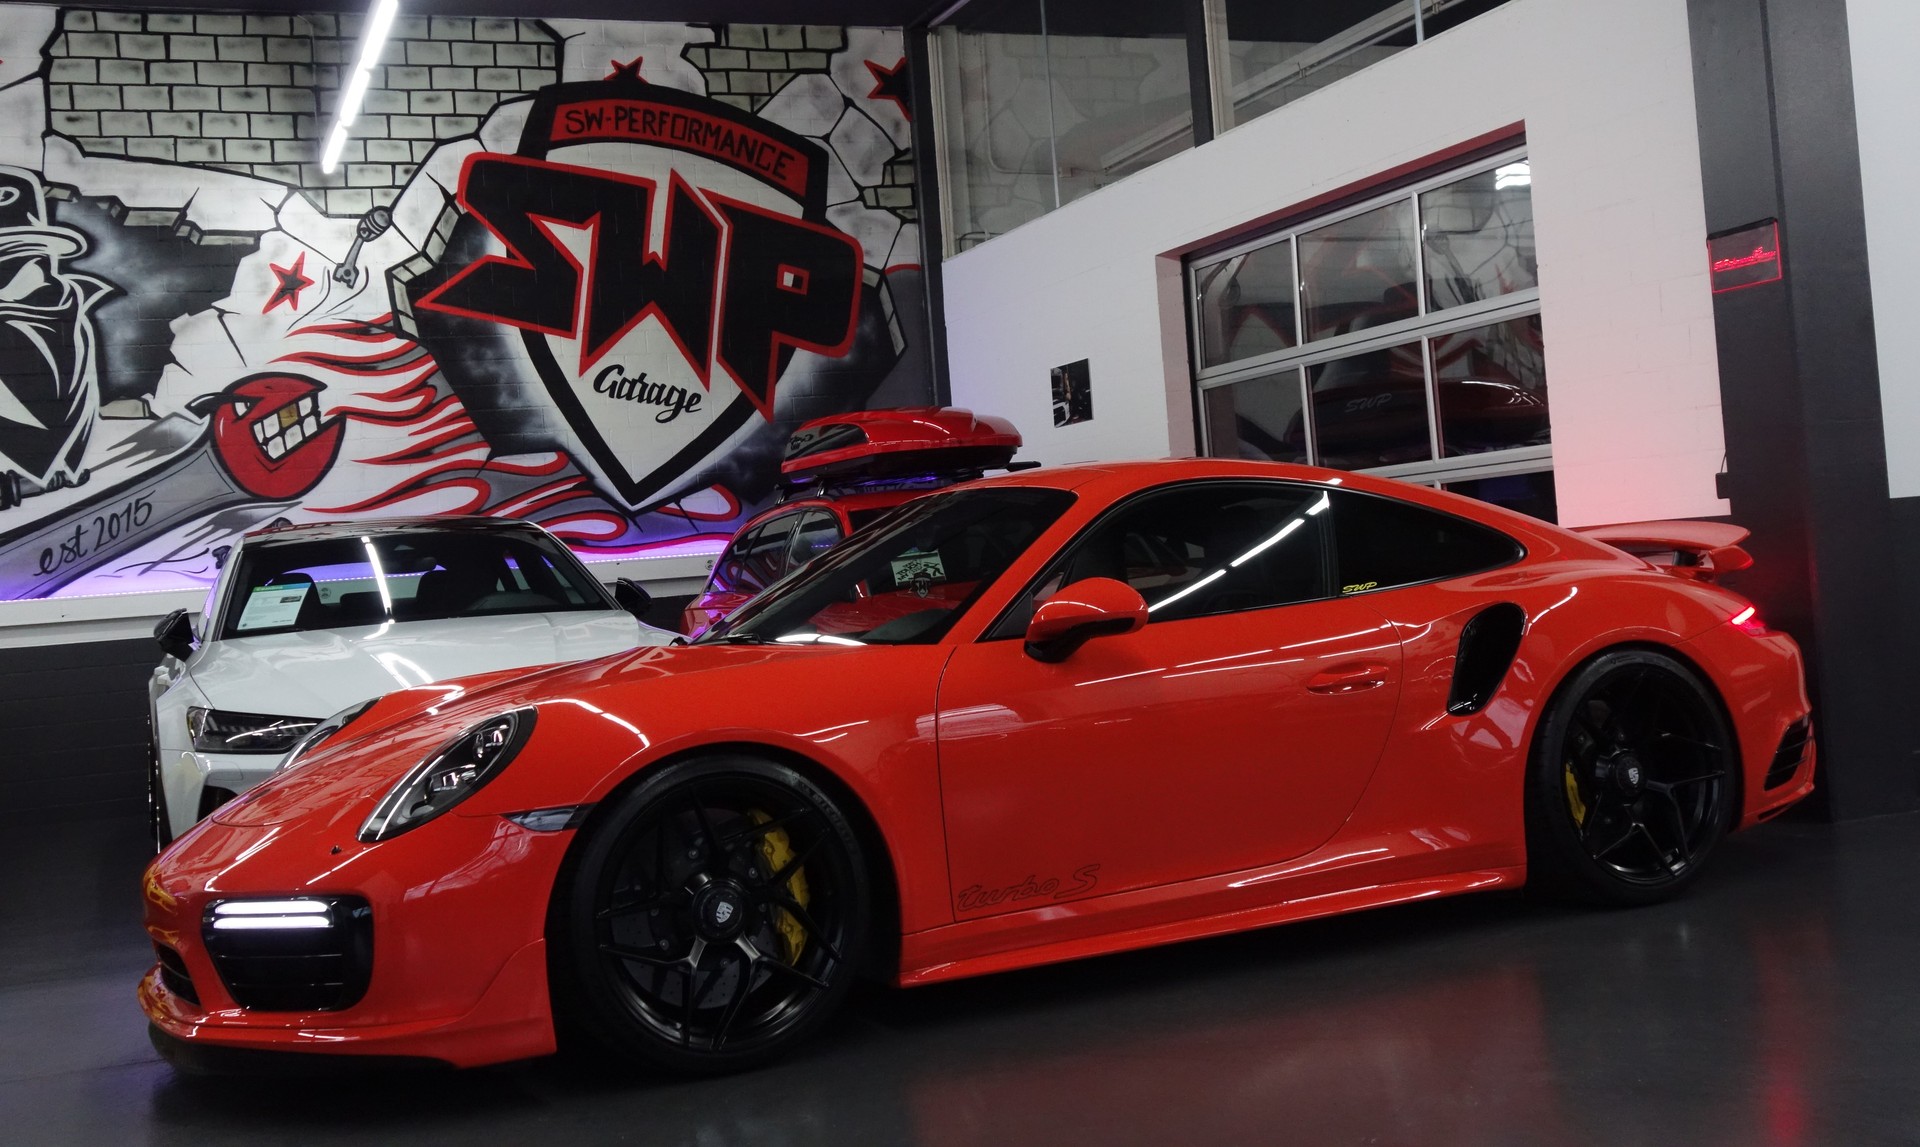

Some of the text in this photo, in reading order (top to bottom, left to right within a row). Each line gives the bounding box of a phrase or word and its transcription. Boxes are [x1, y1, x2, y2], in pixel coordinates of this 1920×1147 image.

[565, 105, 796, 182] SW-PERFORMANCE
[414, 151, 864, 424] SWP
[593, 364, 702, 423] Garage
[33, 490, 156, 576] est 2015
[1342, 581, 1378, 594] SWP
[957, 863, 1101, 912] turbo S
